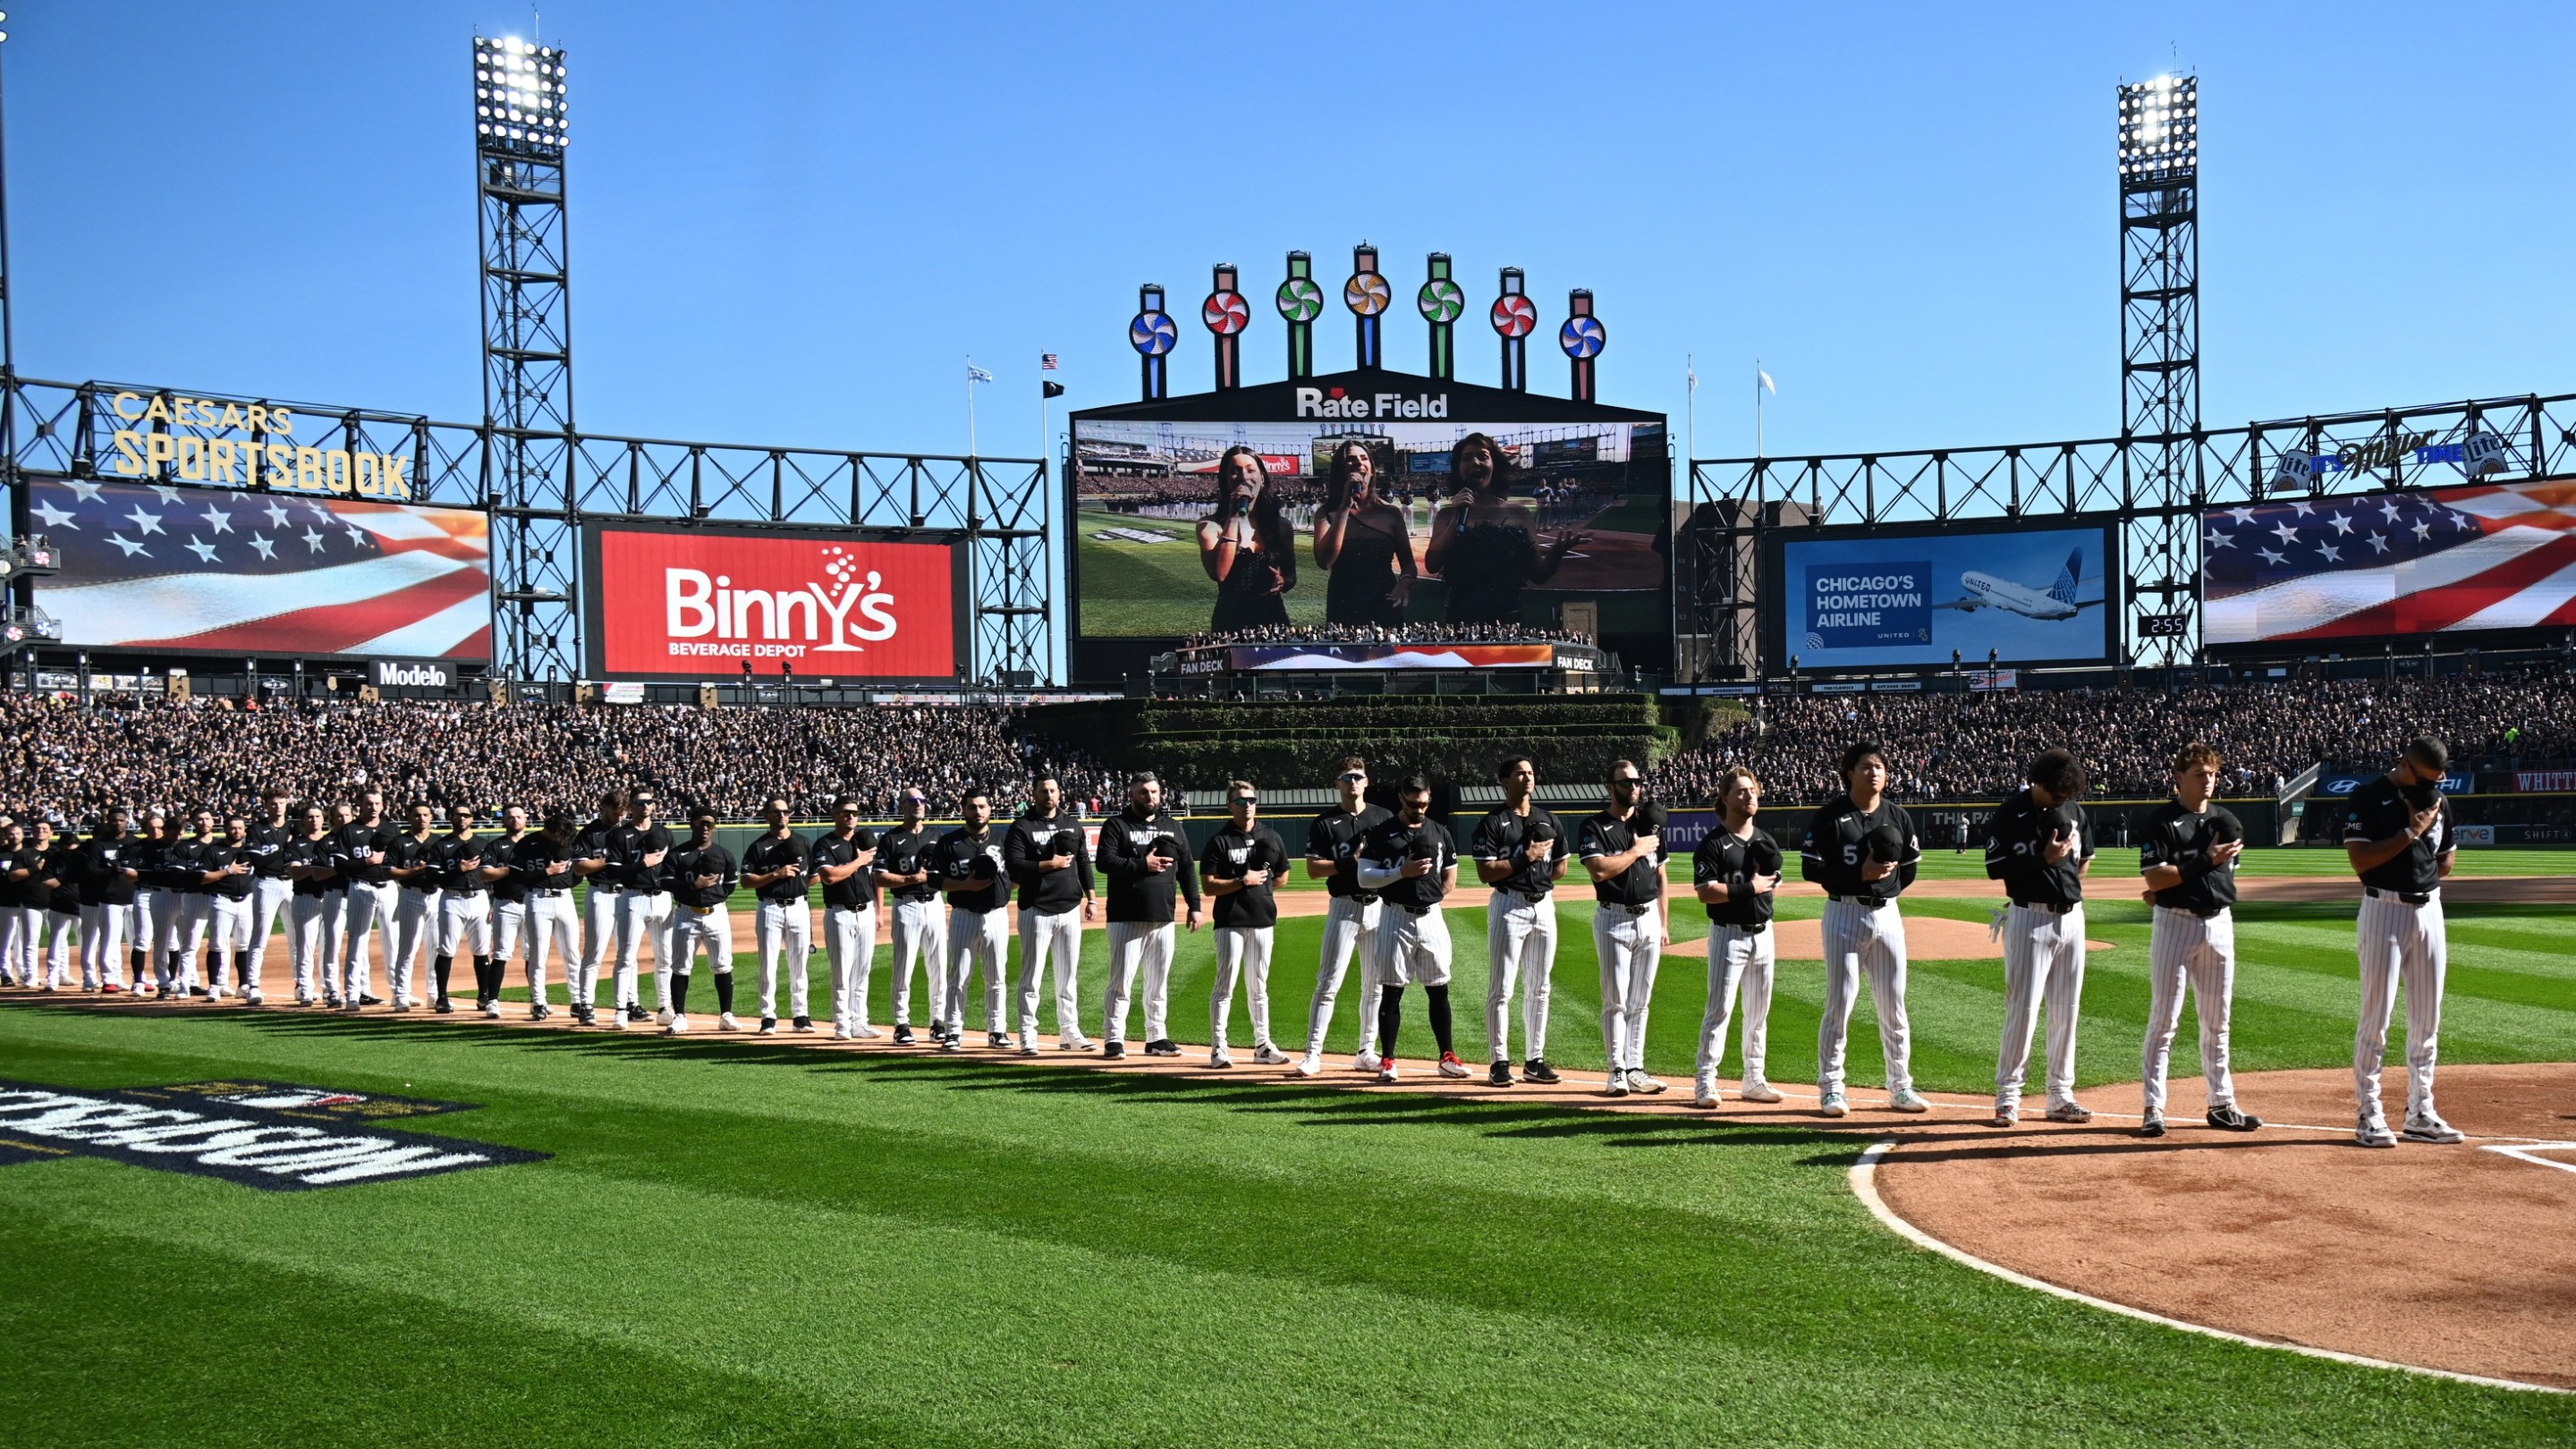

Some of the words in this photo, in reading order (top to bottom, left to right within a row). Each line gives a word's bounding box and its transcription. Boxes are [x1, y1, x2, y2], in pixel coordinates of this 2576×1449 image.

[113, 391, 293, 436] CAESARS
[1296, 387, 1369, 419] Rate
[1375, 394, 1447, 419] Field
[2336, 429, 2437, 480] Miller
[2415, 443, 2463, 464] TIME
[2467, 436, 2498, 463] Lite
[114, 429, 412, 499] SPORTSBOOK
[2279, 456, 2309, 477] Lite
[1816, 575, 1915, 592] CHICAGO'S
[1965, 576, 1991, 592] UNITED
[1817, 593, 1921, 610] HOMETOWN
[1817, 612, 1881, 628] AIRLINE
[2151, 618, 2183, 632] 2:55
[668, 642, 751, 657] BEVERAGE
[754, 644, 807, 657] DEPOT
[1181, 663, 1199, 675] FAN
[1200, 660, 1224, 673] DECK
[1557, 656, 1572, 669] FAN
[1573, 657, 1593, 671] DECK
[379, 663, 447, 687] Modelo
[2517, 771, 2576, 792] WHITT
[1843, 844, 1859, 865] 5
[949, 858, 971, 877] 95
